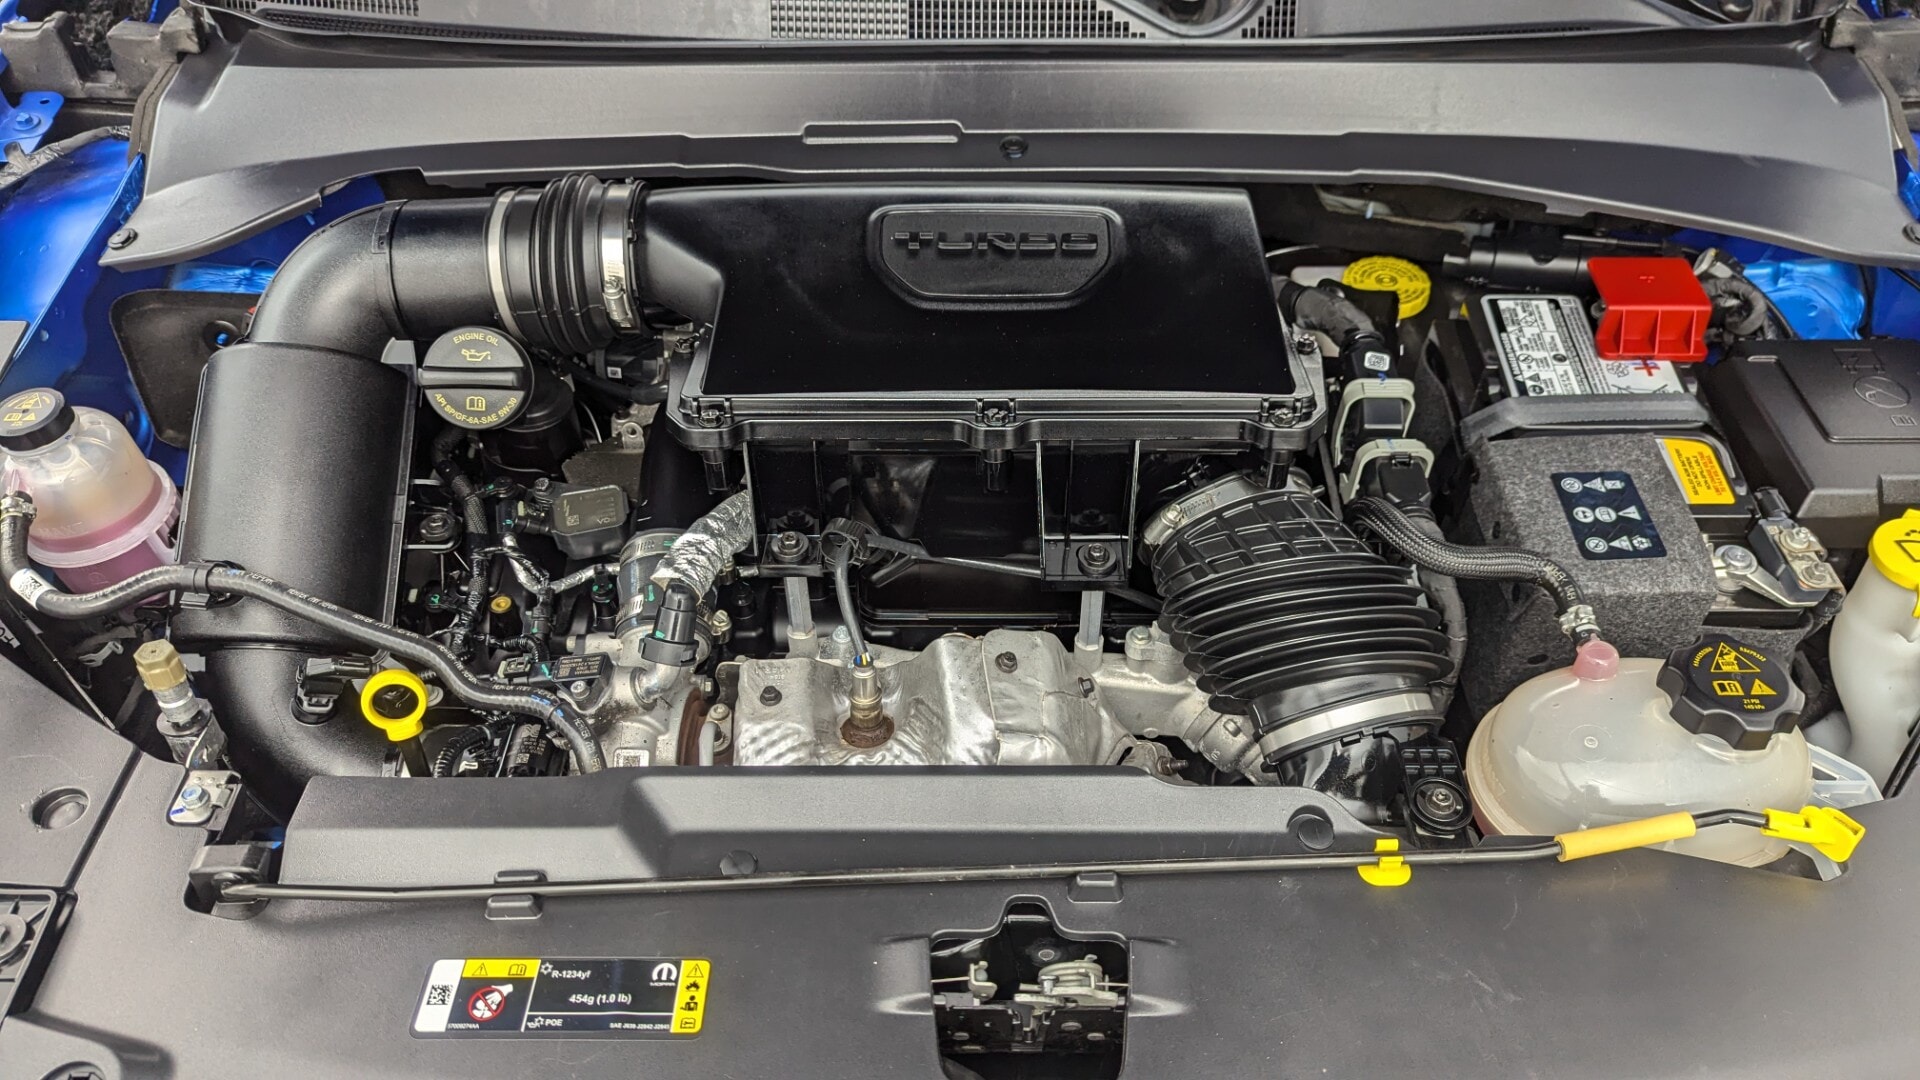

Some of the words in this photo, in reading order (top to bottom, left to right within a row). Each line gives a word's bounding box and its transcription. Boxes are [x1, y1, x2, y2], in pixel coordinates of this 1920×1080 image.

[893, 231, 1099, 254] TURBO
[453, 332, 485, 345] ENGINE
[485, 335, 499, 347] OIL
[434, 393, 447, 407] API
[498, 397, 517, 417] 5W-30
[551, 970, 592, 980] R-1234yf
[569, 994, 595, 1006] 454g
[596, 994, 616, 1006] (1.0
[618, 993, 633, 1005] lb)
[545, 1019, 564, 1027] POE
